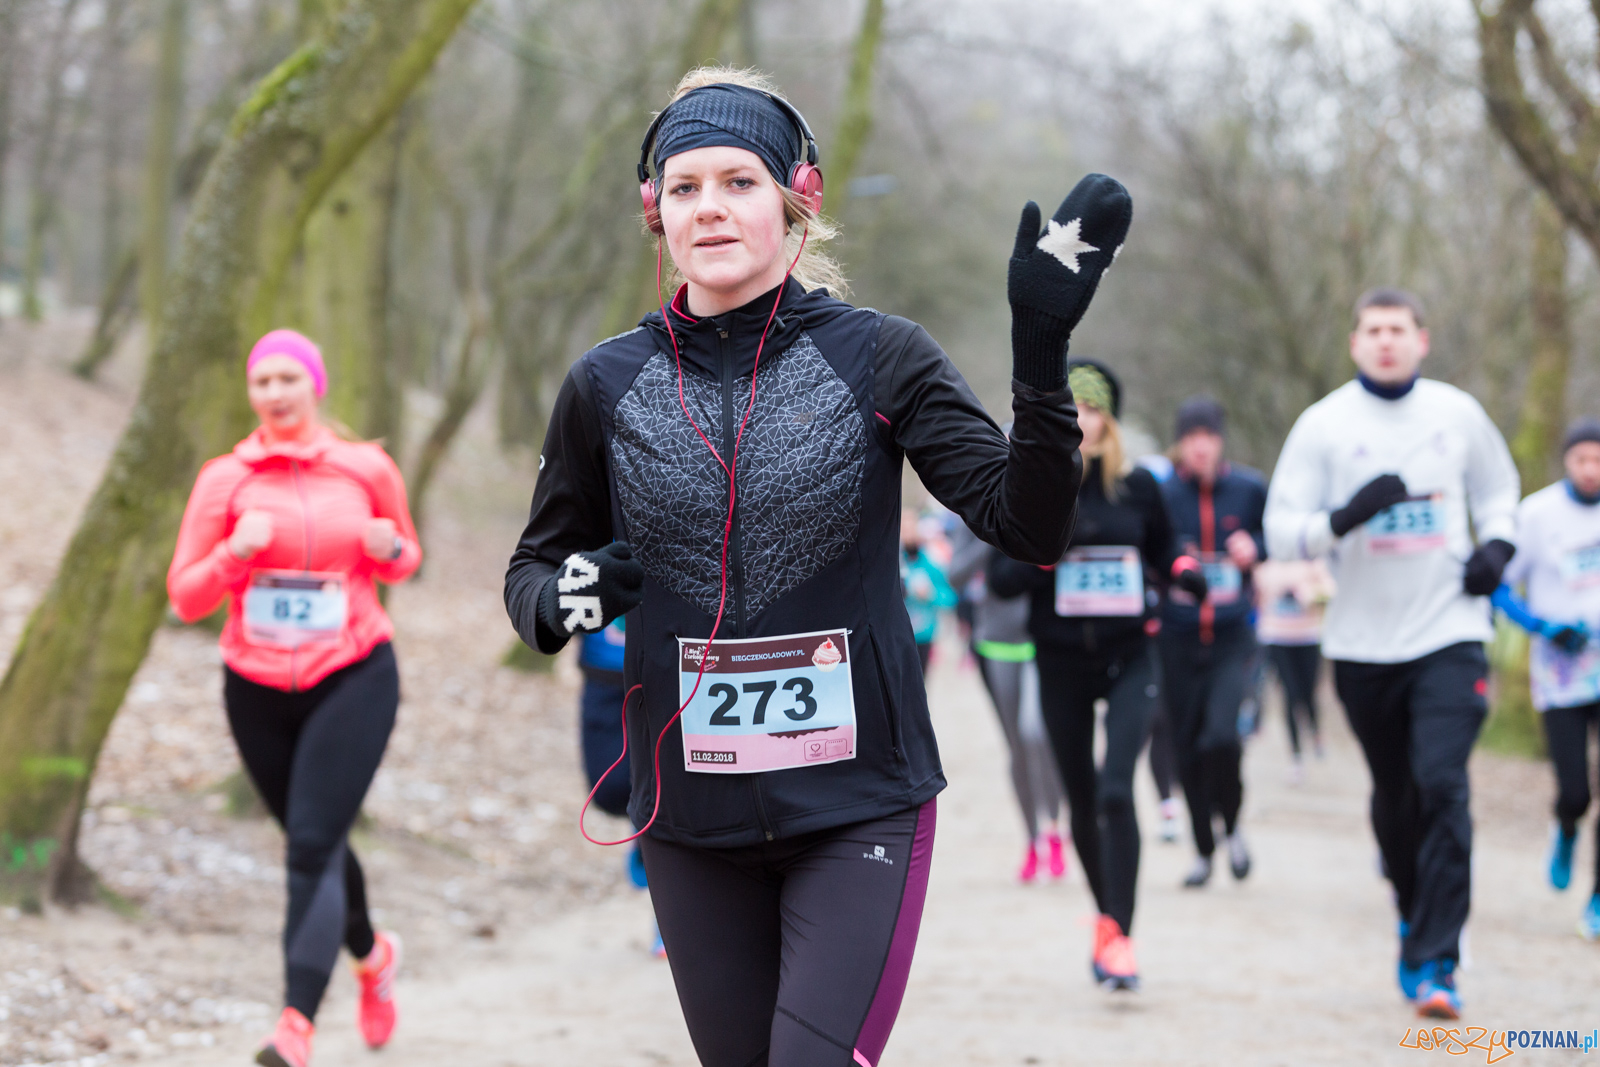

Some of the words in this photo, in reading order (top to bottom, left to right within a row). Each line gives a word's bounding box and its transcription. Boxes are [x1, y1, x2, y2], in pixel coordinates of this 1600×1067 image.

[272, 596, 312, 621] 82
[731, 649, 806, 662] BIEGCZEKOLADOWY.PL
[707, 676, 818, 726] 273
[692, 752, 734, 763] 11.02.2018
